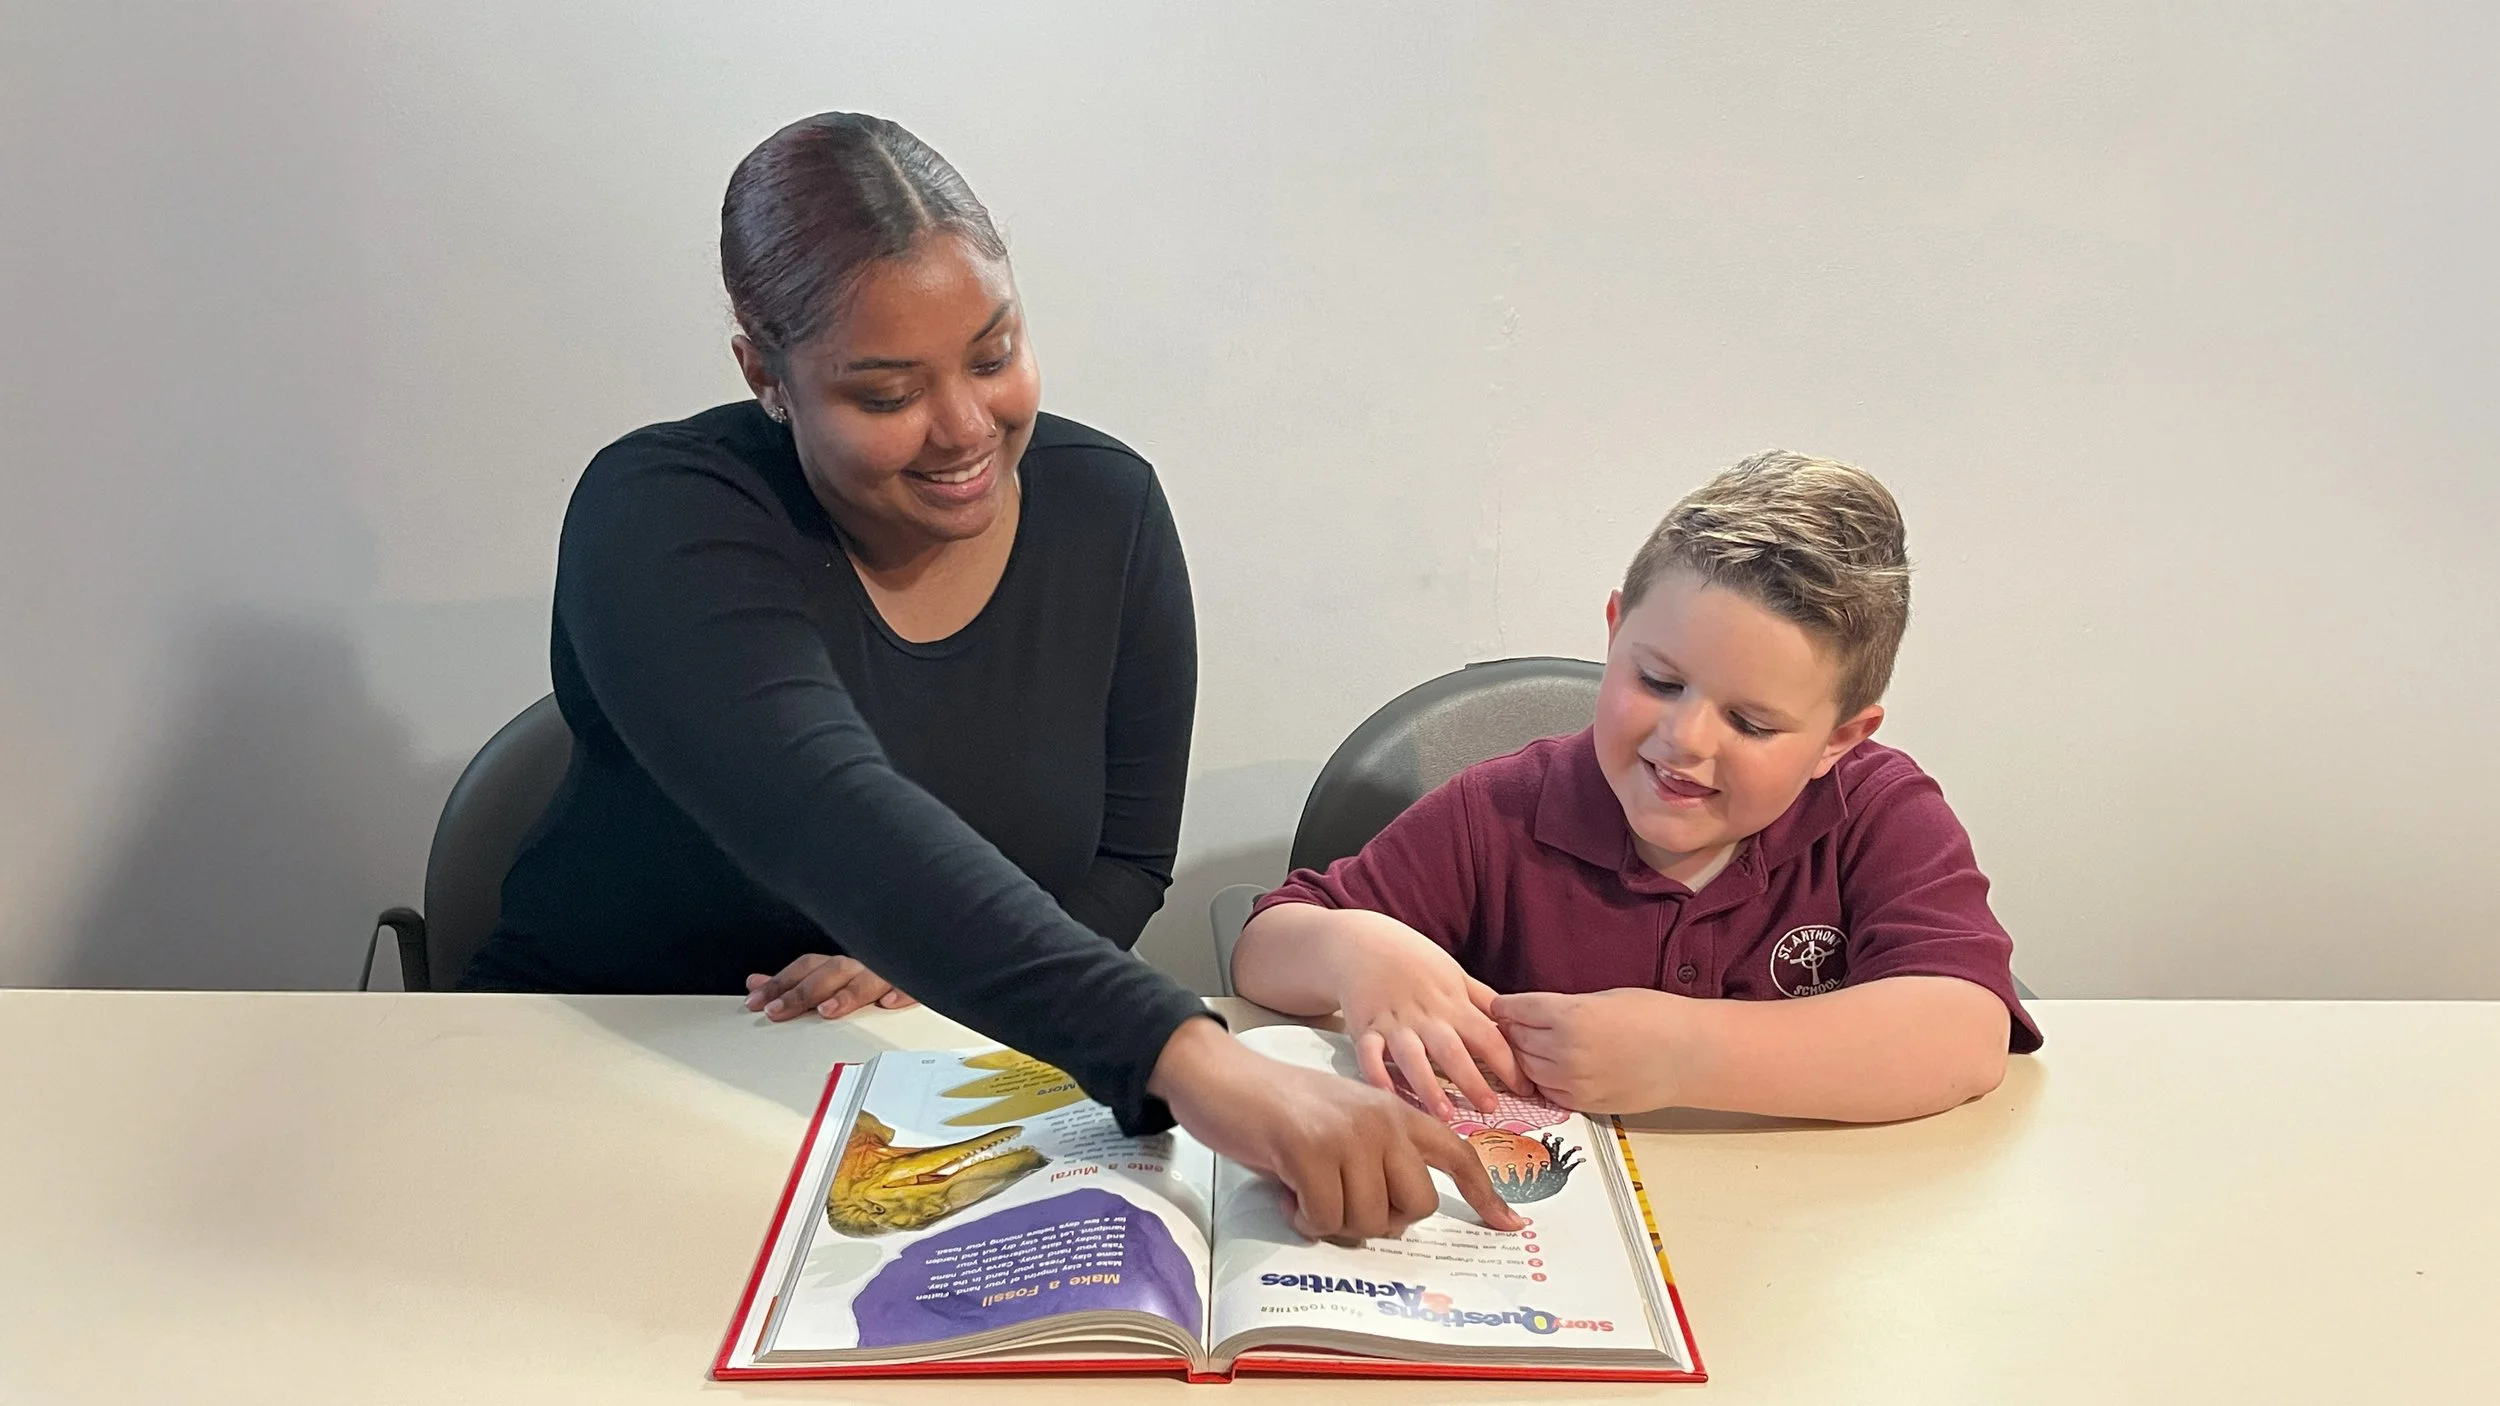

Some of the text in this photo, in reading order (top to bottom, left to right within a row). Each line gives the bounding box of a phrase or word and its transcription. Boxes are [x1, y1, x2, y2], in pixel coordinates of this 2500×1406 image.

[1778, 929, 1842, 960] ST. ANTHONY
[1794, 978, 1840, 996] SCHOOL
[1036, 1081, 1076, 1097] More
[1050, 1162, 1164, 1183] eate a Mural
[1059, 1221, 1080, 1230] days
[1026, 1226, 1055, 1237] before
[989, 1233, 1023, 1246] moving
[1066, 1235, 1102, 1245] today's
[925, 1225, 1126, 1265] handprint. Let the clay dry out and harden
[965, 1241, 986, 1251] your
[1041, 1241, 1062, 1250] date
[1075, 1242, 1097, 1252] your
[935, 1246, 962, 1256] fossil.
[982, 1246, 1037, 1264] underneath
[1047, 1248, 1071, 1258] hand
[1018, 1253, 1044, 1264] away.
[1038, 1257, 1065, 1267] Press
[1435, 1255, 1474, 1263] changed
[955, 1259, 978, 1269] your
[985, 1260, 1014, 1271] Carve
[1013, 1264, 1034, 1274] your
[1062, 1263, 1082, 1271] clay
[960, 1266, 982, 1277] your
[985, 1270, 1009, 1280] hand
[1023, 1268, 1057, 1281] imprint
[930, 1272, 957, 1282] name
[972, 1275, 981, 1283] in
[1009, 1276, 1020, 1284] of
[927, 1281, 949, 1291] clay.
[952, 1278, 968, 1287] the
[984, 1279, 1006, 1289] your
[954, 1285, 980, 1295] hand.
[981, 1273, 1120, 1308] Make a Fossil
[1260, 1273, 1426, 1308] Activities
[915, 1291, 949, 1301] Flatten
[1260, 1303, 1325, 1313] TOGETHER
[1378, 1301, 1559, 1335] Questions
[1552, 1317, 1614, 1332] Story
